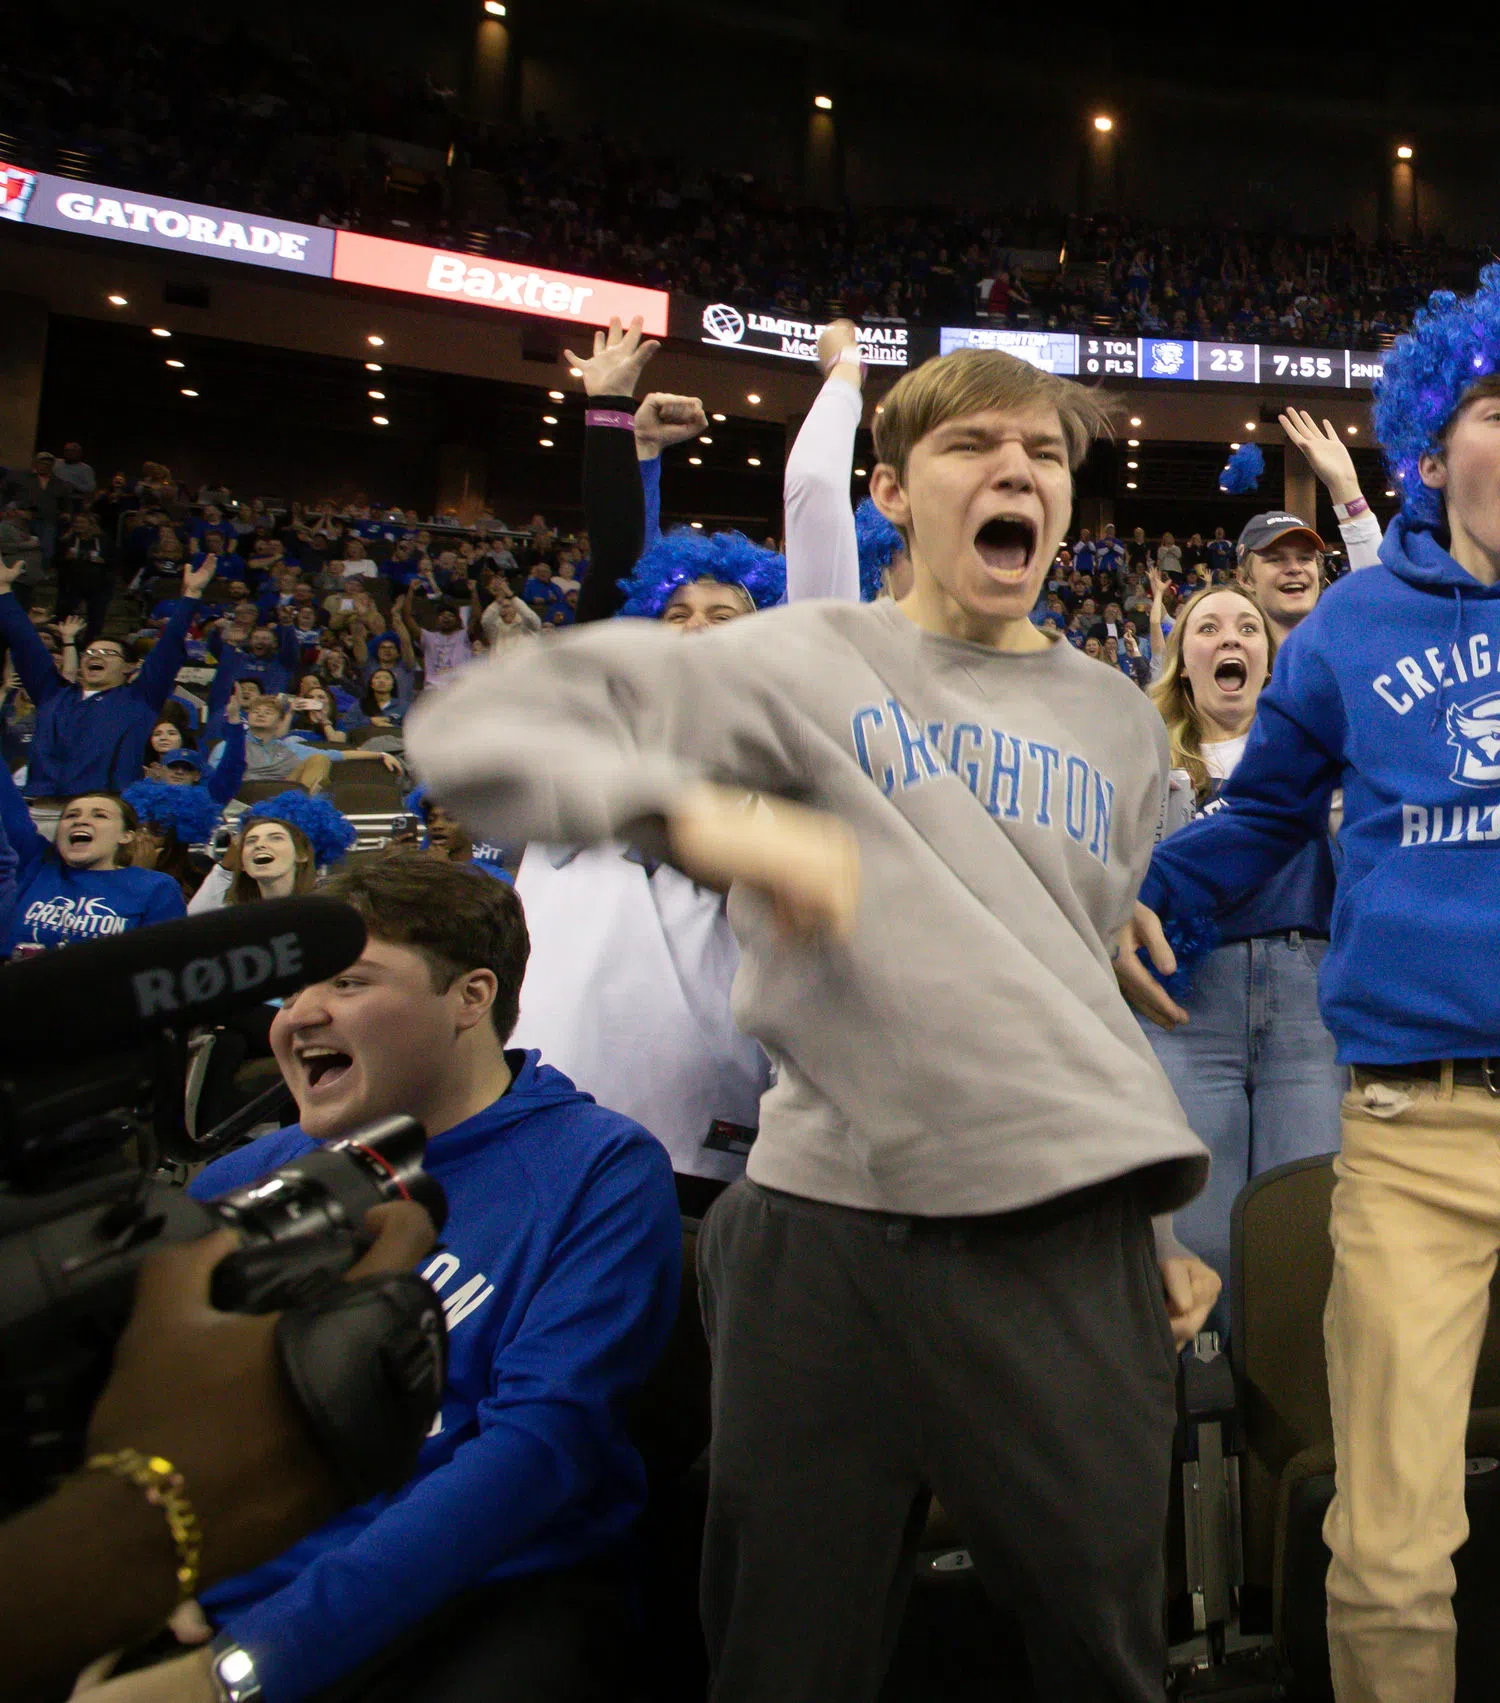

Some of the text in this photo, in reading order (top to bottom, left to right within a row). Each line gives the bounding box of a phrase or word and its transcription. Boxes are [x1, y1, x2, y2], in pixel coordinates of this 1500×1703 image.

[56, 192, 310, 261] GATORADE
[427, 254, 593, 315] Baxter
[747, 312, 909, 346] LIMITLE MALE
[858, 343, 908, 361] Clinic
[1087, 339, 1136, 357] 3 TOL
[1209, 348, 1246, 373] 23
[1086, 358, 1135, 375] 0 FLS
[1272, 354, 1333, 379] 7:55
[1350, 362, 1385, 379] 2ND
[851, 697, 1115, 867] CRGHTON
[25, 900, 128, 936] CREIGHTON
[131, 932, 304, 1018] RØDE
